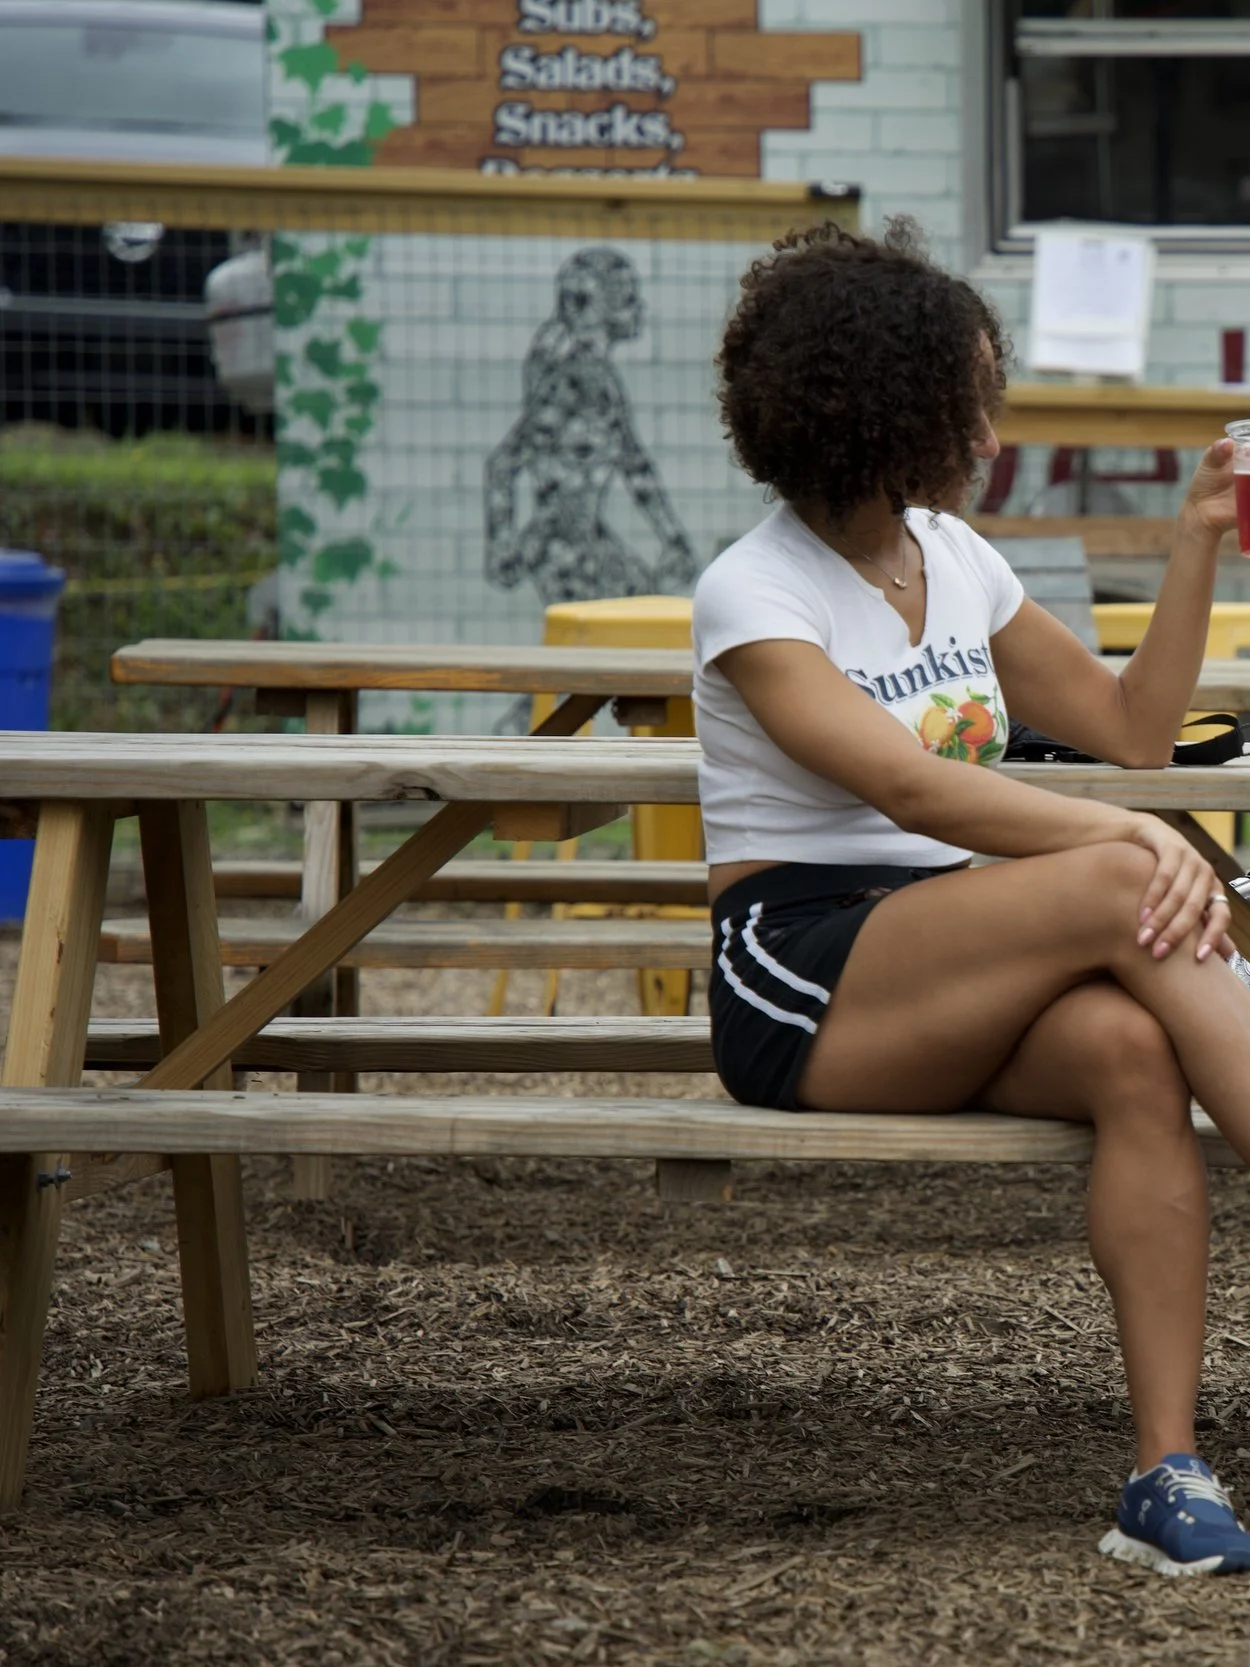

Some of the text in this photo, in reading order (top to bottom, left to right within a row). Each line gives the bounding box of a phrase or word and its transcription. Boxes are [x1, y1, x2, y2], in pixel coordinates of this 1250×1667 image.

[518, 0, 657, 41] Subs,
[499, 44, 677, 98] Salads,
[494, 101, 686, 153] Snacks,
[845, 636, 996, 706] Sunkist
